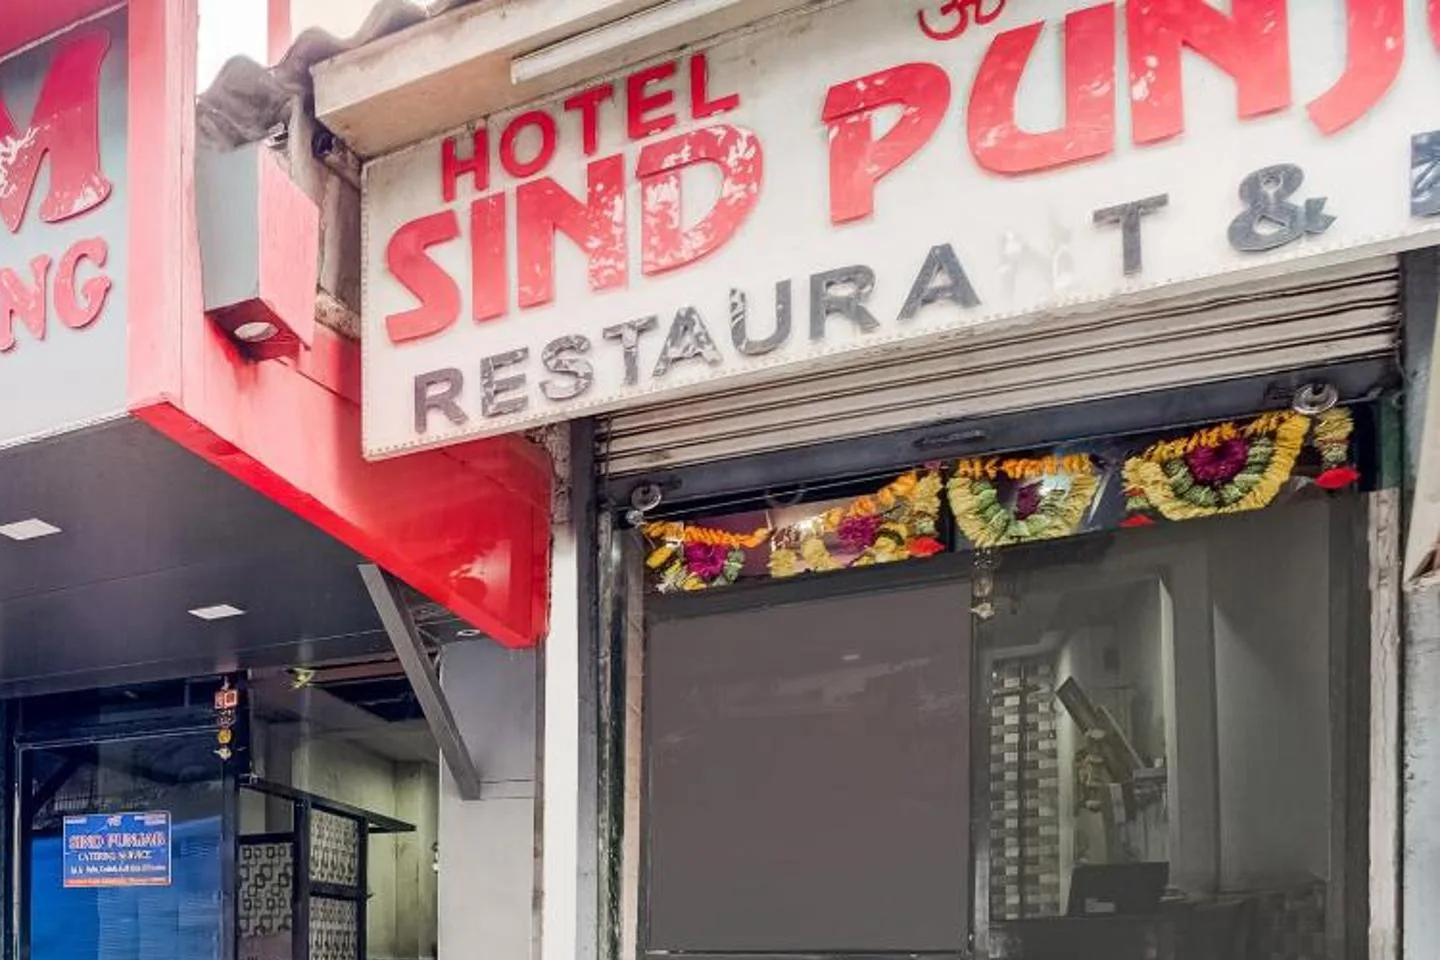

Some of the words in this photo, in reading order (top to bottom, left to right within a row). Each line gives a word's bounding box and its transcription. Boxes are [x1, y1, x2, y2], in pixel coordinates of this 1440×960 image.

[384, 123, 766, 346] SIND
[819, 0, 1440, 225] PUNJ
[440, 51, 741, 204] HOTEL
[1226, 162, 1339, 253] &
